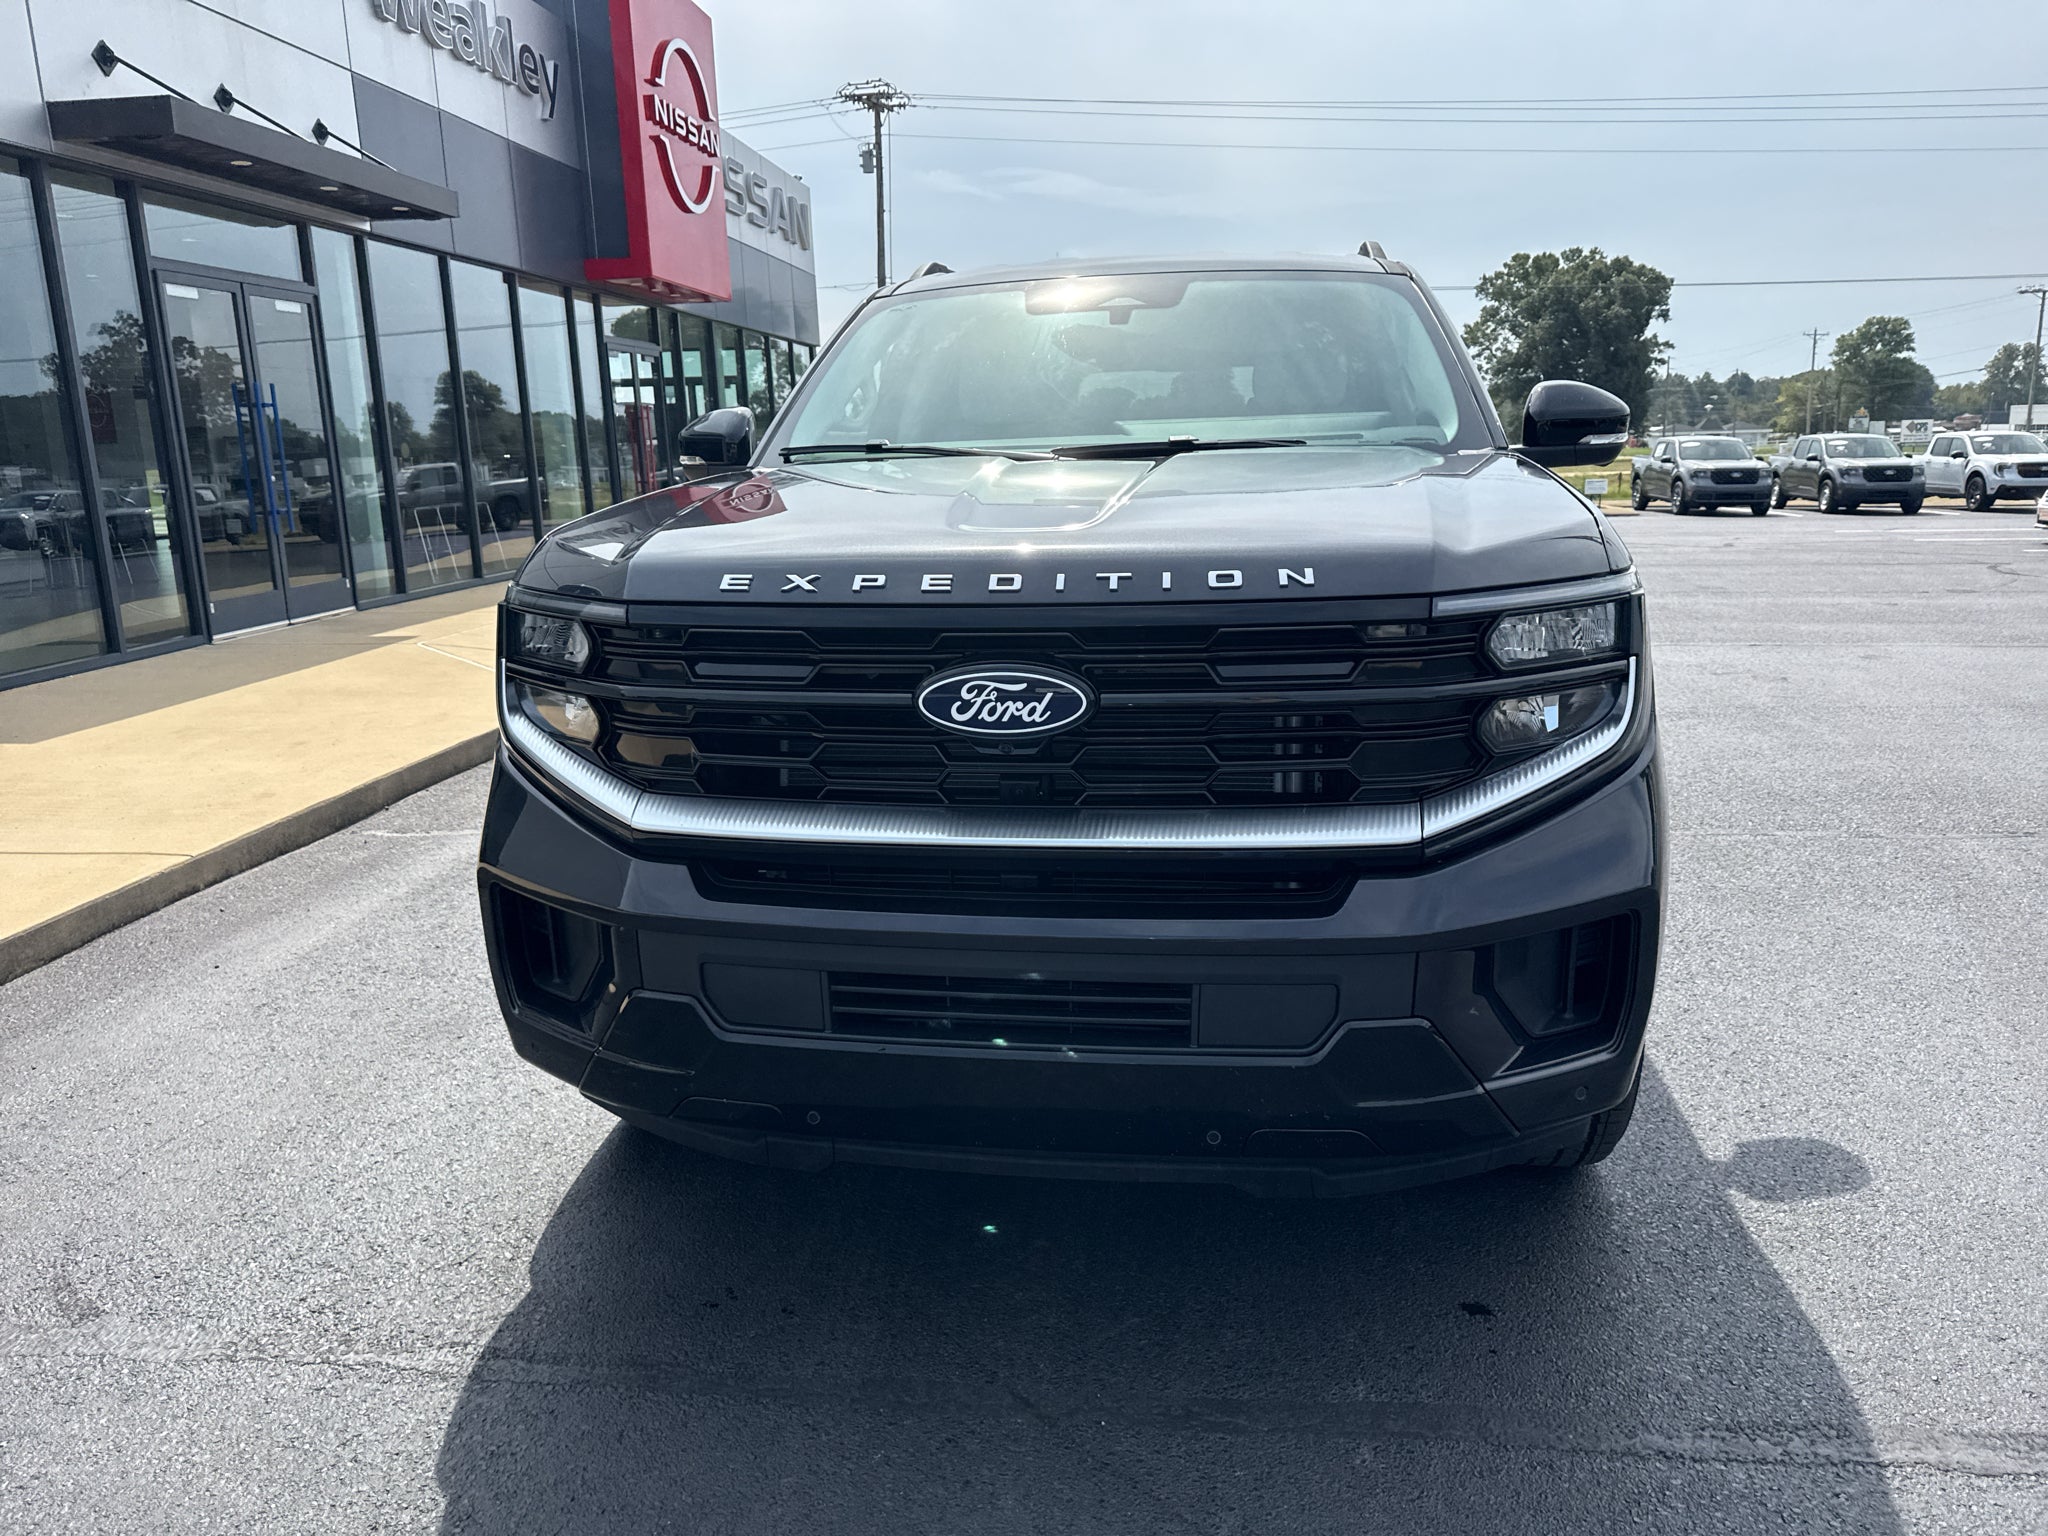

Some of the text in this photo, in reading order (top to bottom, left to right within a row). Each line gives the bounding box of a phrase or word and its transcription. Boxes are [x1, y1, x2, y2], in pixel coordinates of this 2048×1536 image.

[652, 94, 721, 158] NISSAN
[719, 567, 1315, 592] EXPEDITION
[950, 680, 1054, 723] Ford
